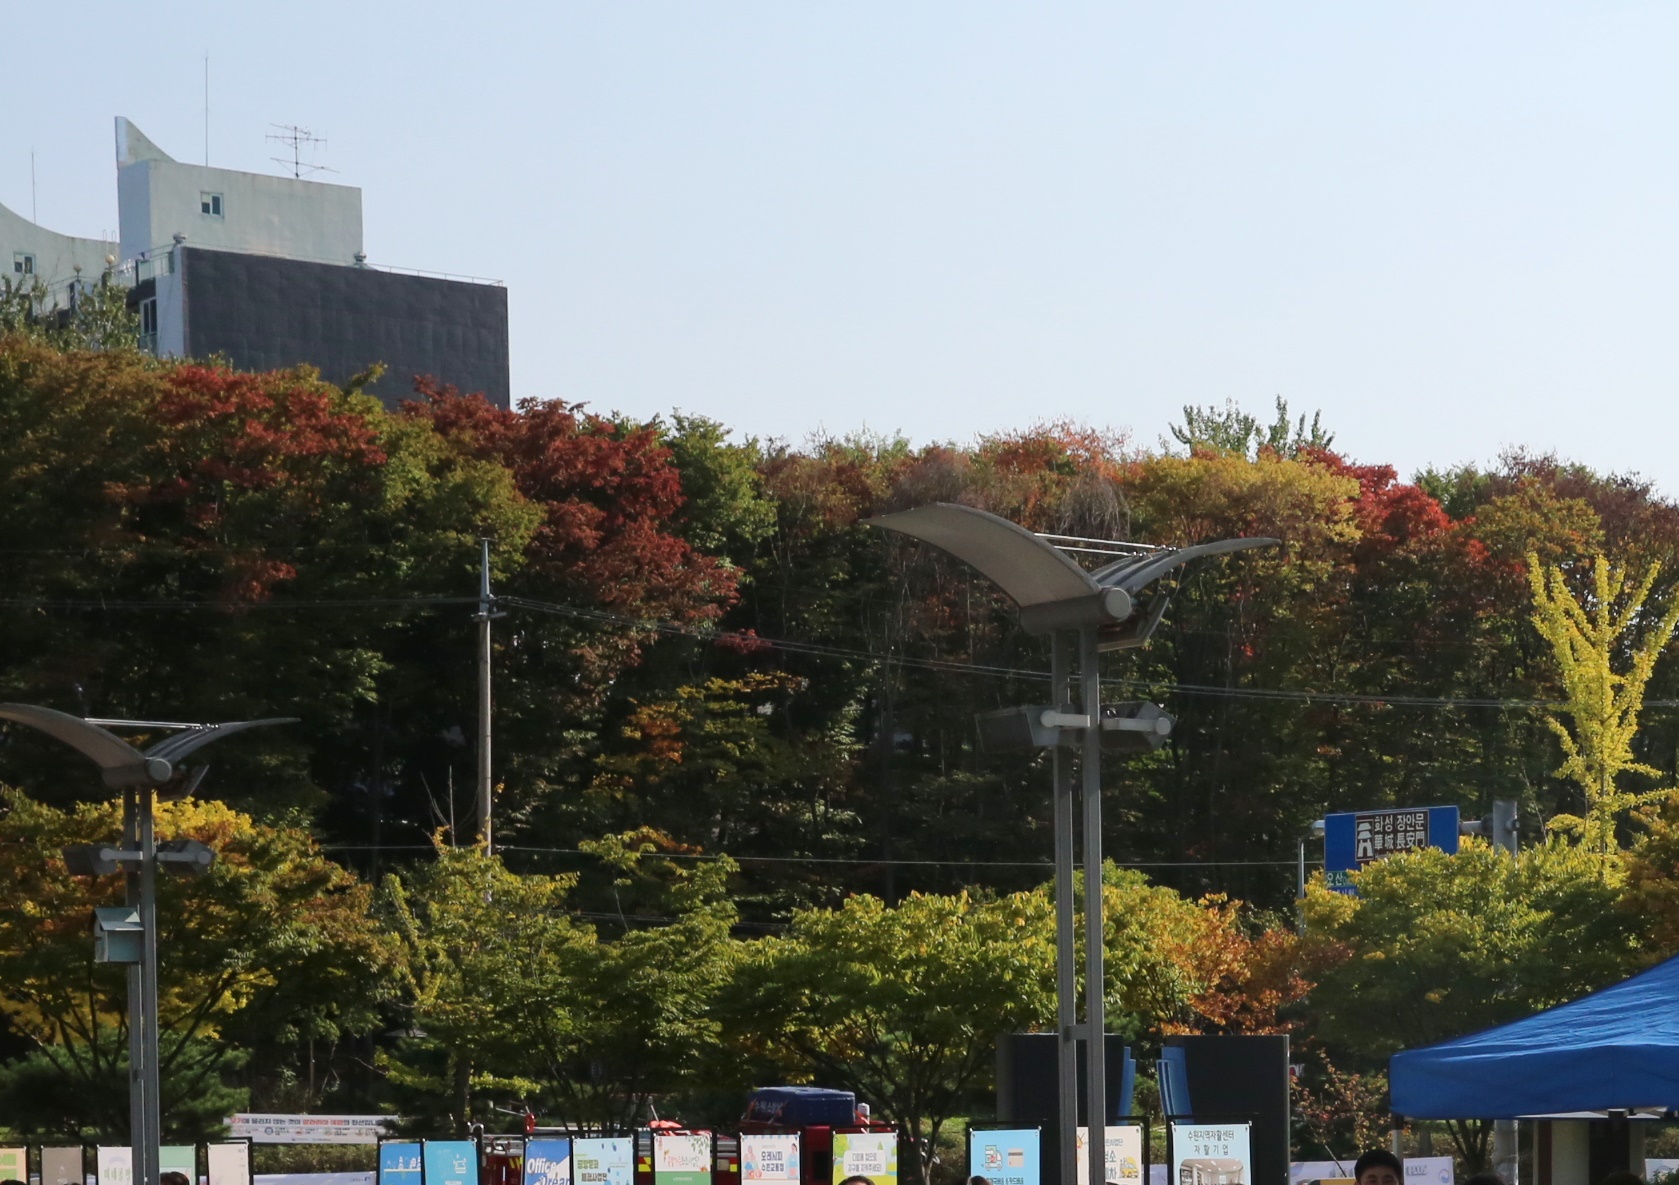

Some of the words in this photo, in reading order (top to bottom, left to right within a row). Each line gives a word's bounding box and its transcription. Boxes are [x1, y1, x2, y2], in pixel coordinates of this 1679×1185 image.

[1375, 816, 1394, 832] 화성
[1396, 813, 1425, 831] 장안문
[1374, 834, 1394, 850] 華城
[1396, 830, 1425, 849] 長安門
[1326, 872, 1344, 887] 오산
